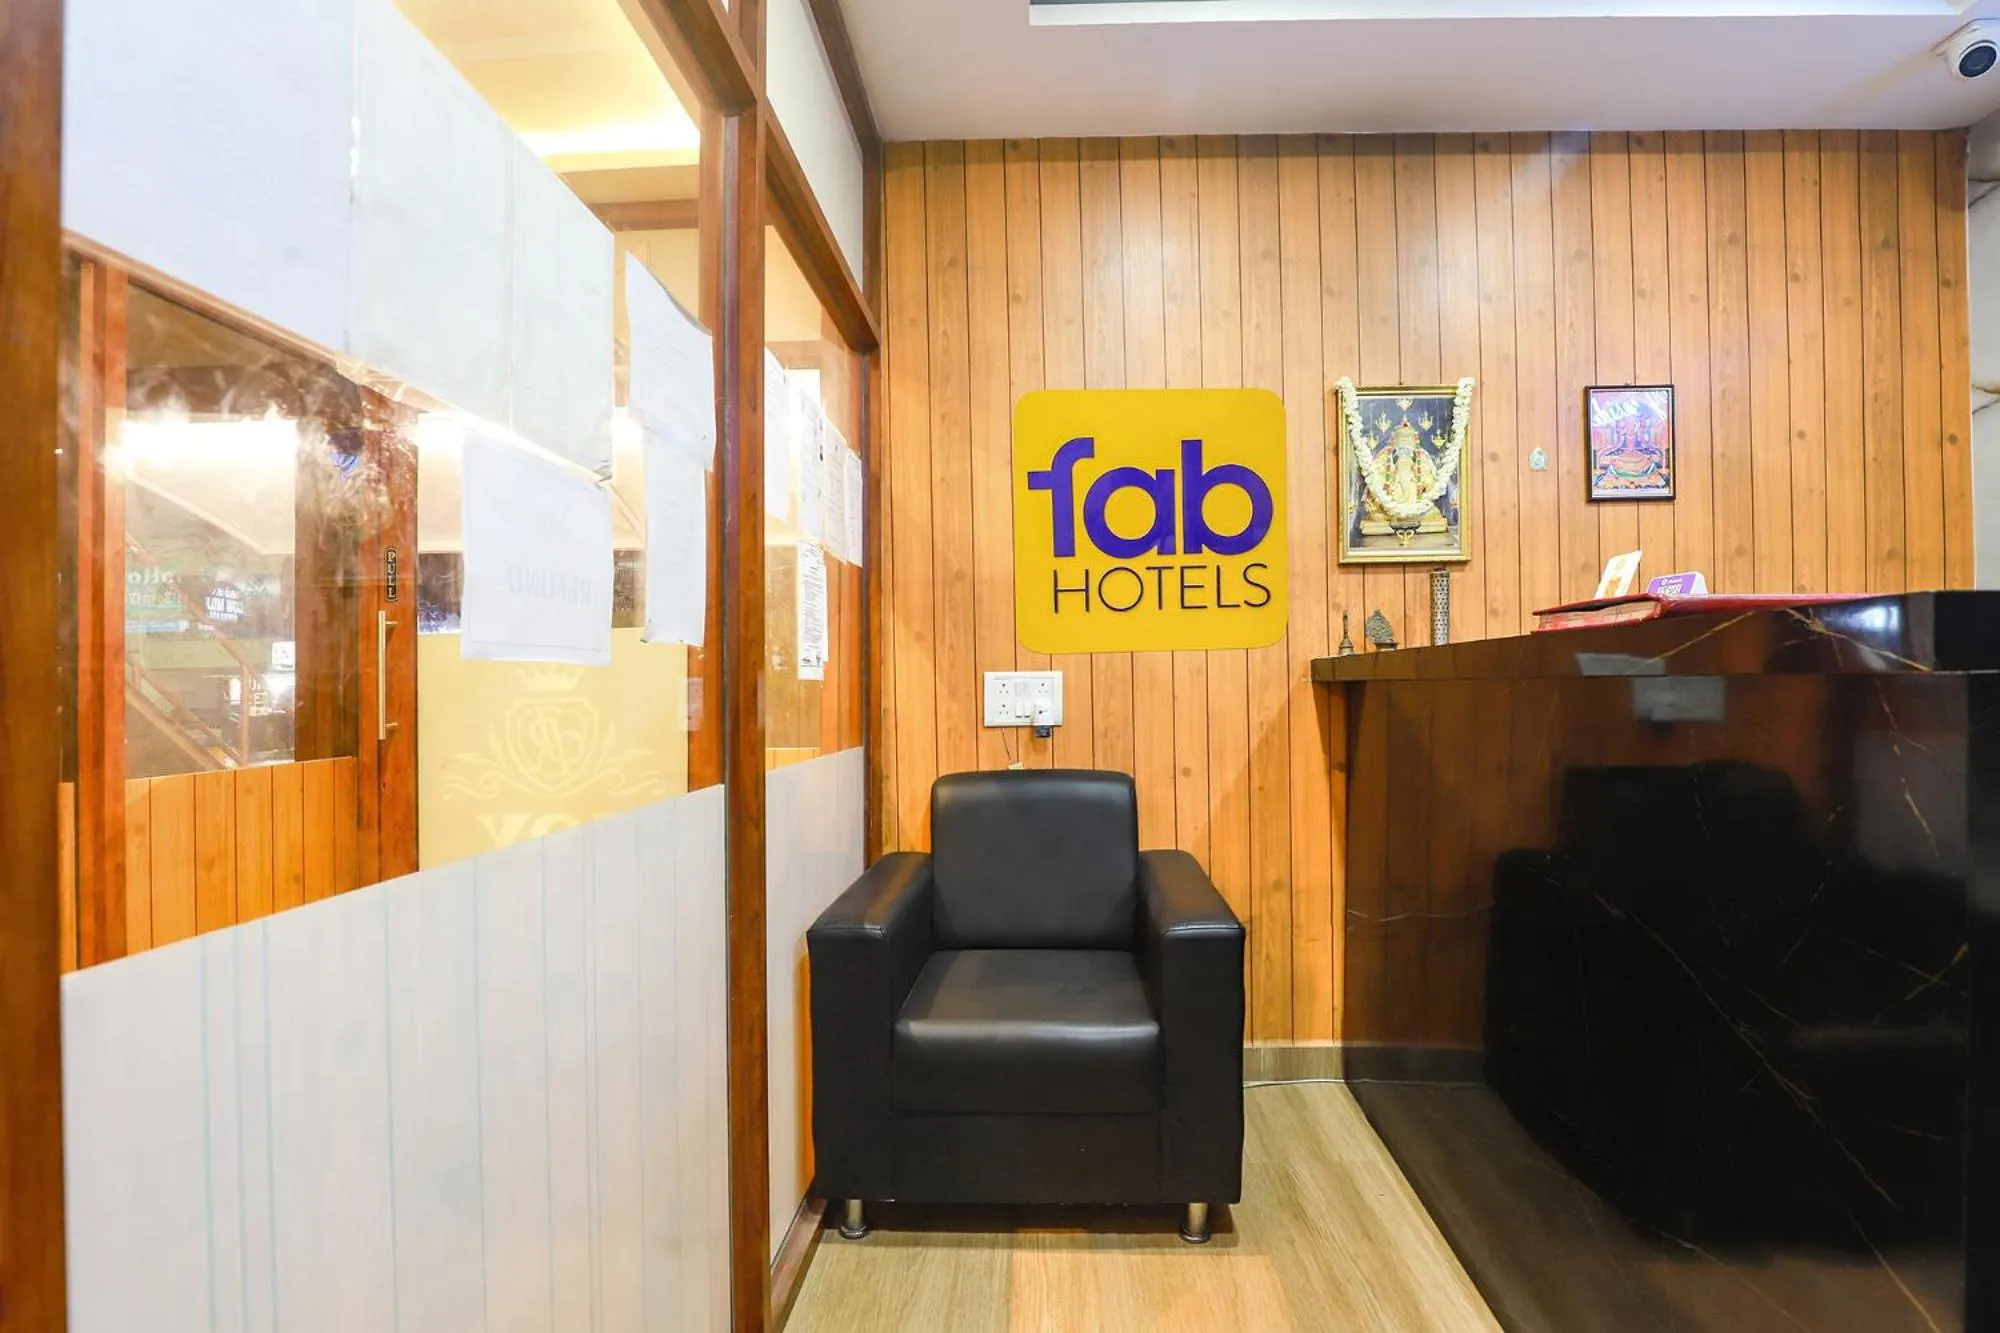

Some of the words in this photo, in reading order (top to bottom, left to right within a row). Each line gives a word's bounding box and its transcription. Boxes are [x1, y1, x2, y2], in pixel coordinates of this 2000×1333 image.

[1028, 437, 1273, 559] fab
[387, 551, 396, 598] PULL
[1053, 563, 1272, 614] HOTELS
